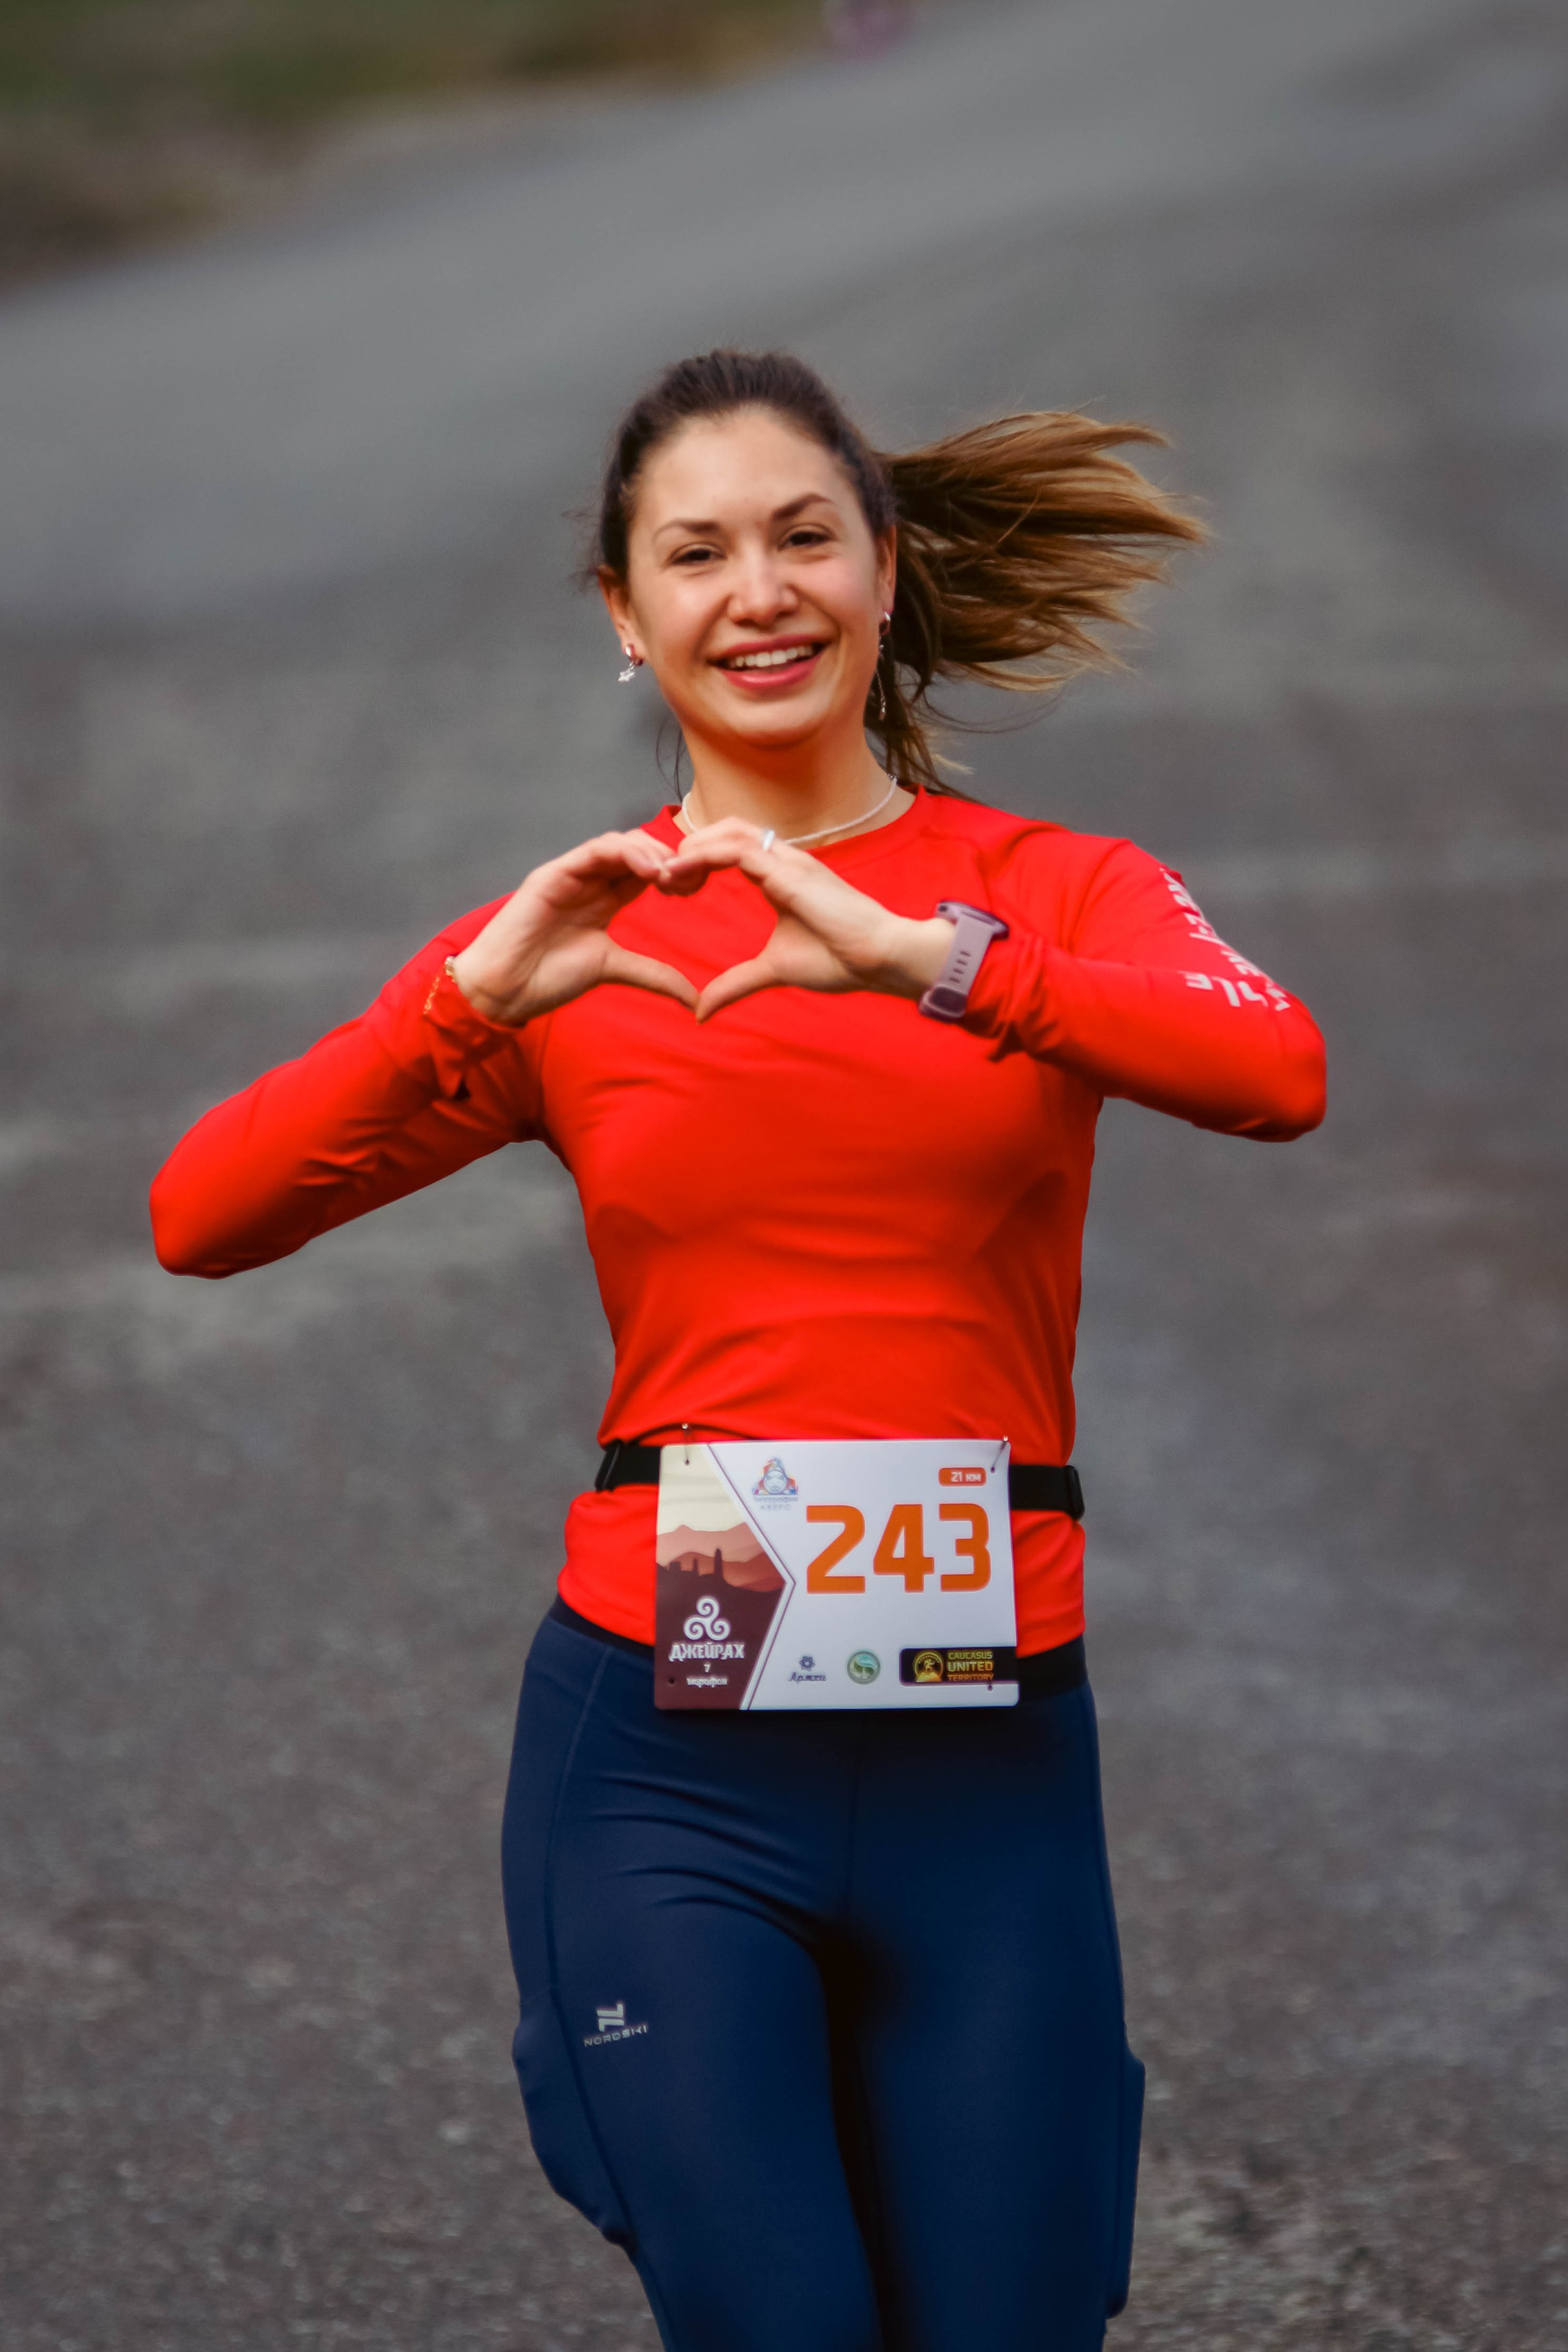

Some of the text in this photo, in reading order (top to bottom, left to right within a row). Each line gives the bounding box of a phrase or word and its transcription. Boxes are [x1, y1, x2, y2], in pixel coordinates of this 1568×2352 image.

[951, 1471, 962, 1482] 21
[806, 1504, 992, 1593] 243
[668, 1642, 745, 1662] ДЖЕЙРАХ
[948, 1651, 993, 1660] CAUCASUS
[703, 1663, 711, 1673] 7
[948, 1661, 993, 1672] UNITED
[948, 1673, 994, 1682] TERRITORY
[583, 2025, 647, 2048] NORDSKI
